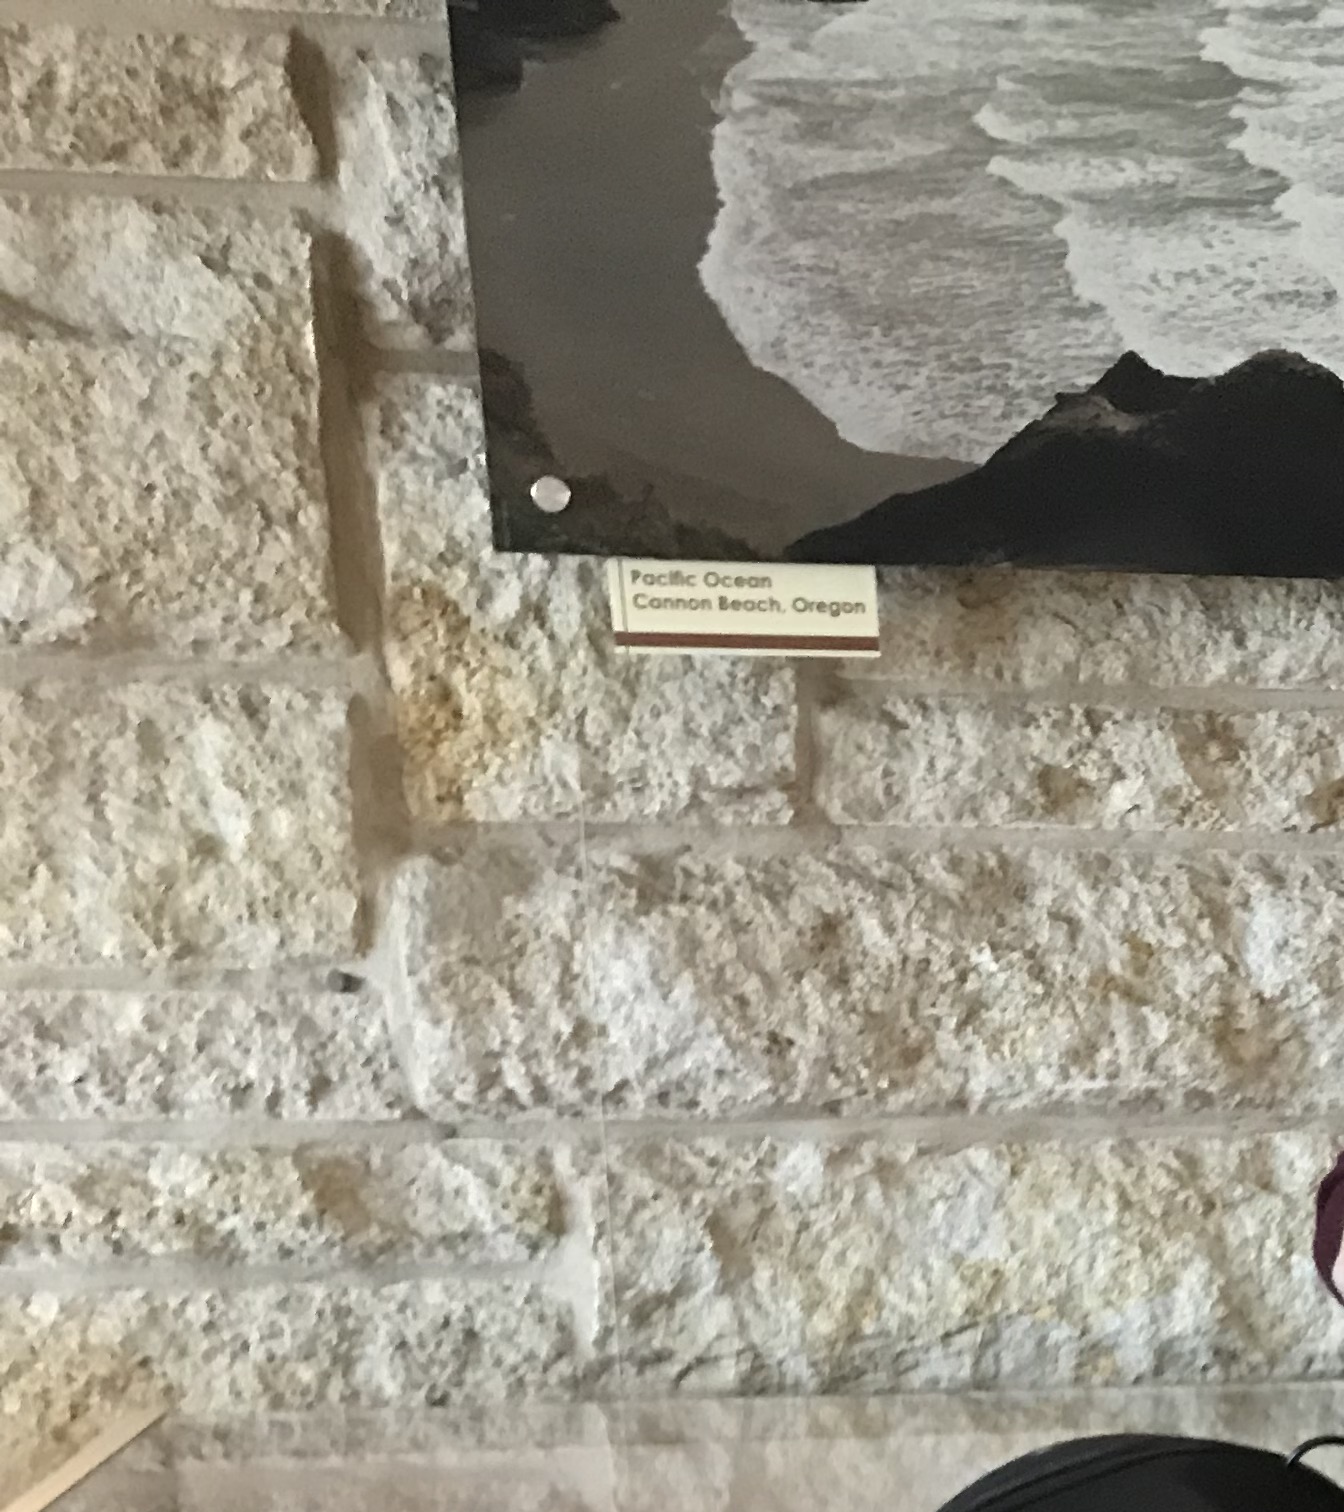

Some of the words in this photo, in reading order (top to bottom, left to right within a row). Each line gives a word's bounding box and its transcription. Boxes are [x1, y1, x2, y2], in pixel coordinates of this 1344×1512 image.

[630, 570, 697, 587] Pacific
[704, 571, 772, 587] Ocean
[632, 593, 712, 610] Cannon
[792, 597, 866, 617] Oregon
